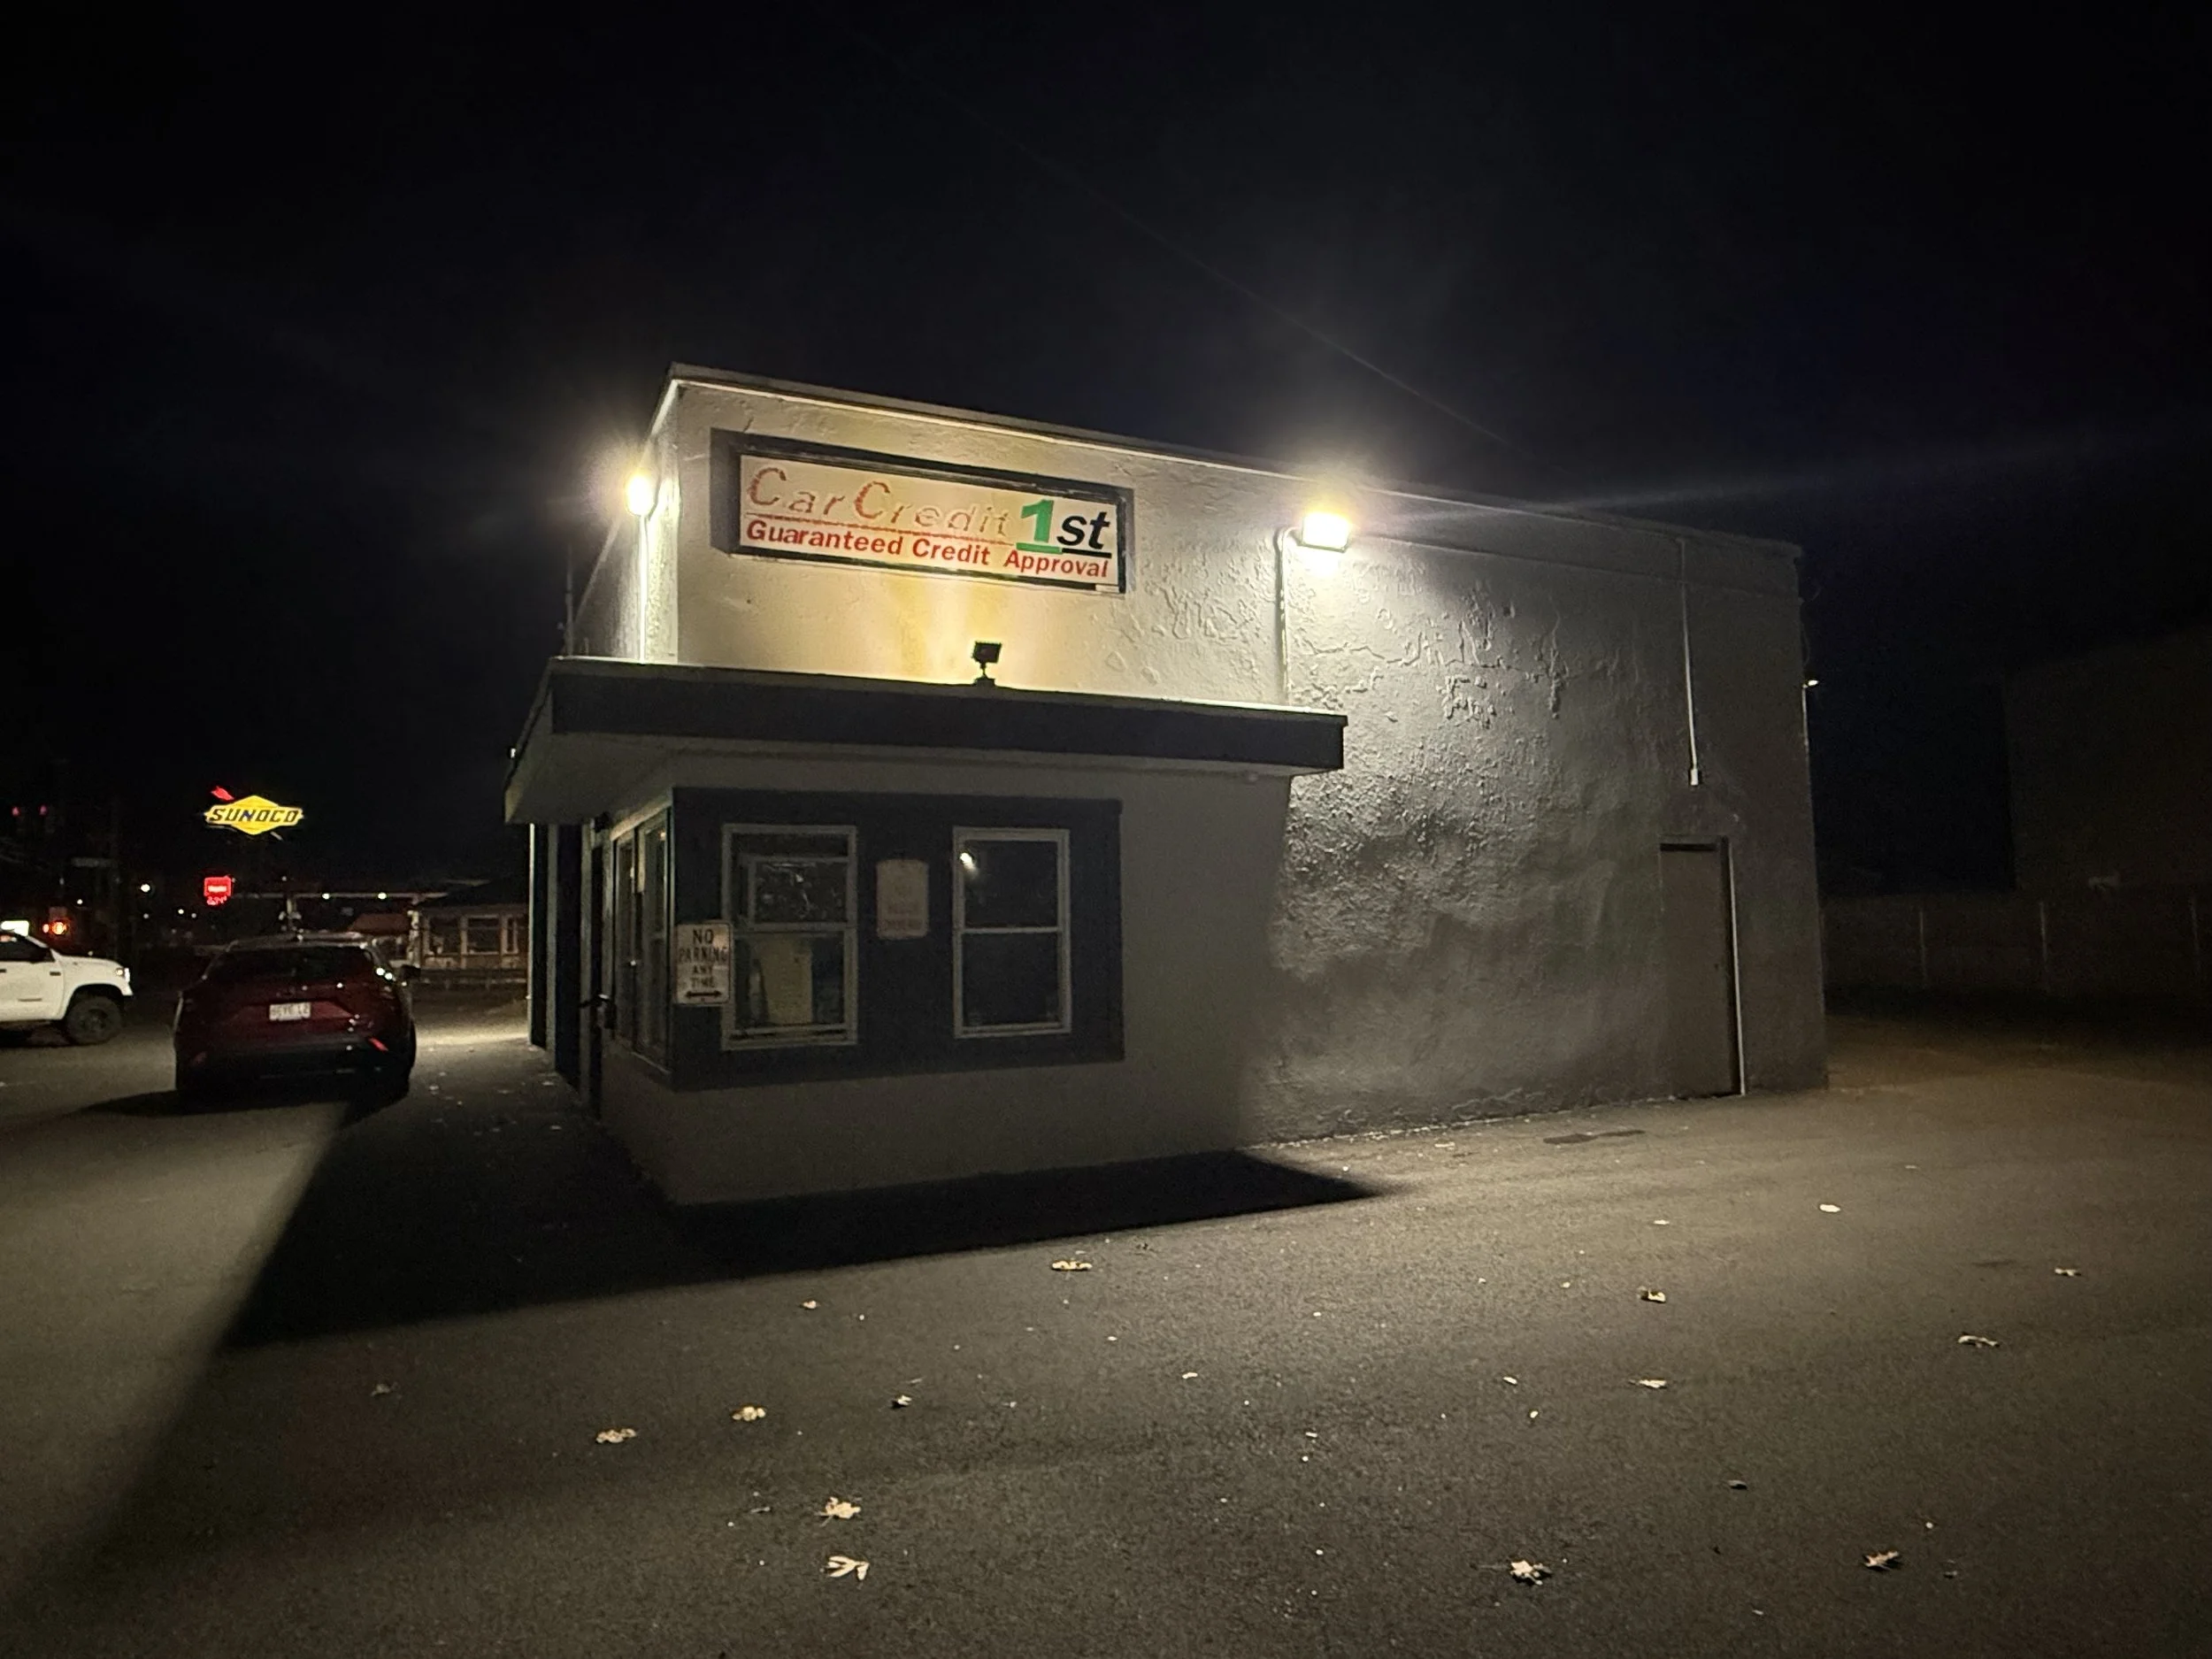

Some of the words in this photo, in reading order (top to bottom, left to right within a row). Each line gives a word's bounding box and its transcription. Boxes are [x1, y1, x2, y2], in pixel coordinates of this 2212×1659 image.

[1019, 499, 1111, 550] 1st
[746, 519, 904, 556] Guaranteed
[912, 537, 991, 566] Credit
[1002, 549, 1109, 579] Approval
[209, 807, 300, 824] SUNOCO
[693, 928, 715, 945] NO
